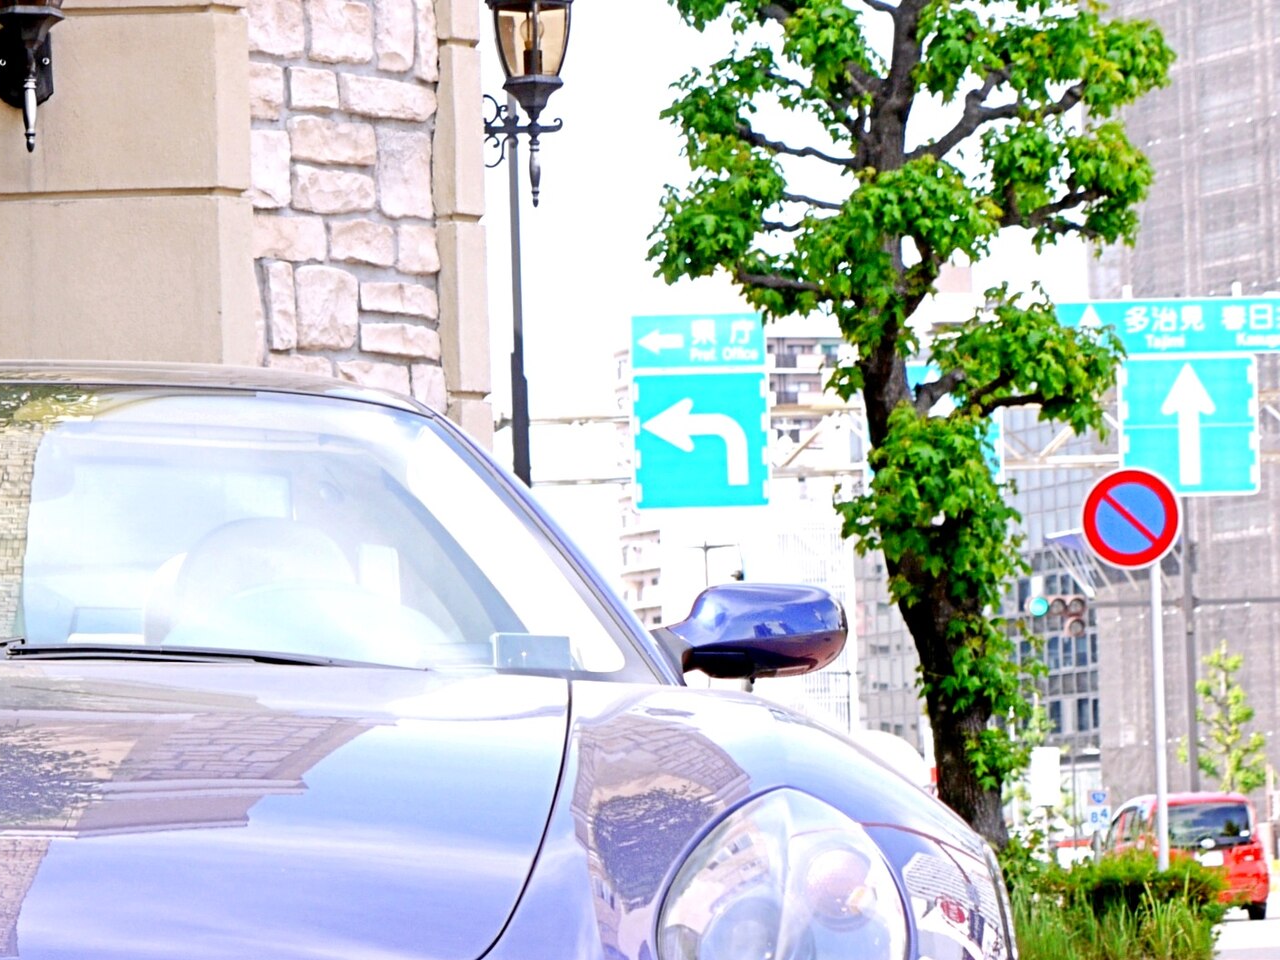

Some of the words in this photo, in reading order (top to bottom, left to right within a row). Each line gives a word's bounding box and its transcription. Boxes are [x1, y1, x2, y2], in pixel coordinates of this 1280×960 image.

[1124, 305, 1205, 333] 多治見
[1221, 303, 1280, 330] 春日
